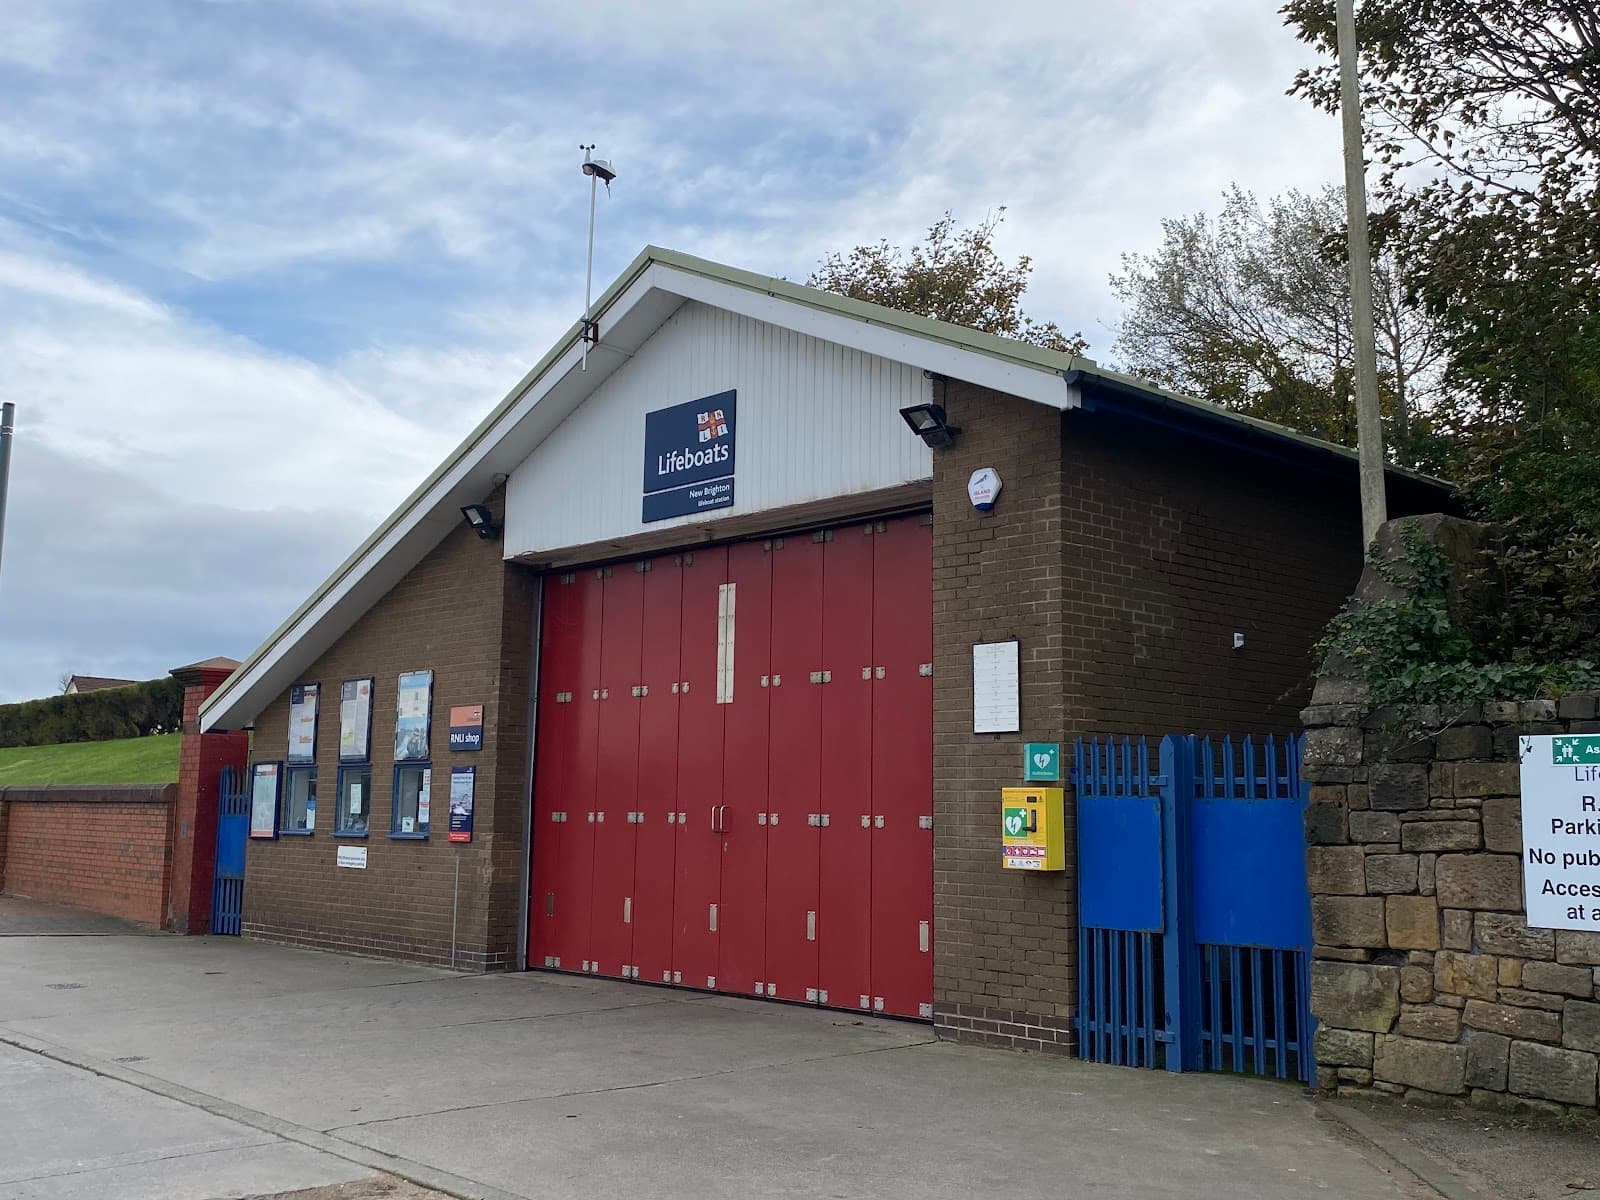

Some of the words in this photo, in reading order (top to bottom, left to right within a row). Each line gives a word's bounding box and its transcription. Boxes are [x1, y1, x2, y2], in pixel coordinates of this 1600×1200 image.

[658, 443, 729, 475] Lifeboats
[689, 490, 704, 498] New
[704, 484, 730, 496] Brighton
[450, 733, 465, 744] RNLI
[465, 732, 480, 744] shop
[1529, 848, 1556, 865] No
[1563, 850, 1600, 869] pub
[1541, 879, 1600, 897] Acces
[1567, 904, 1585, 920] at
